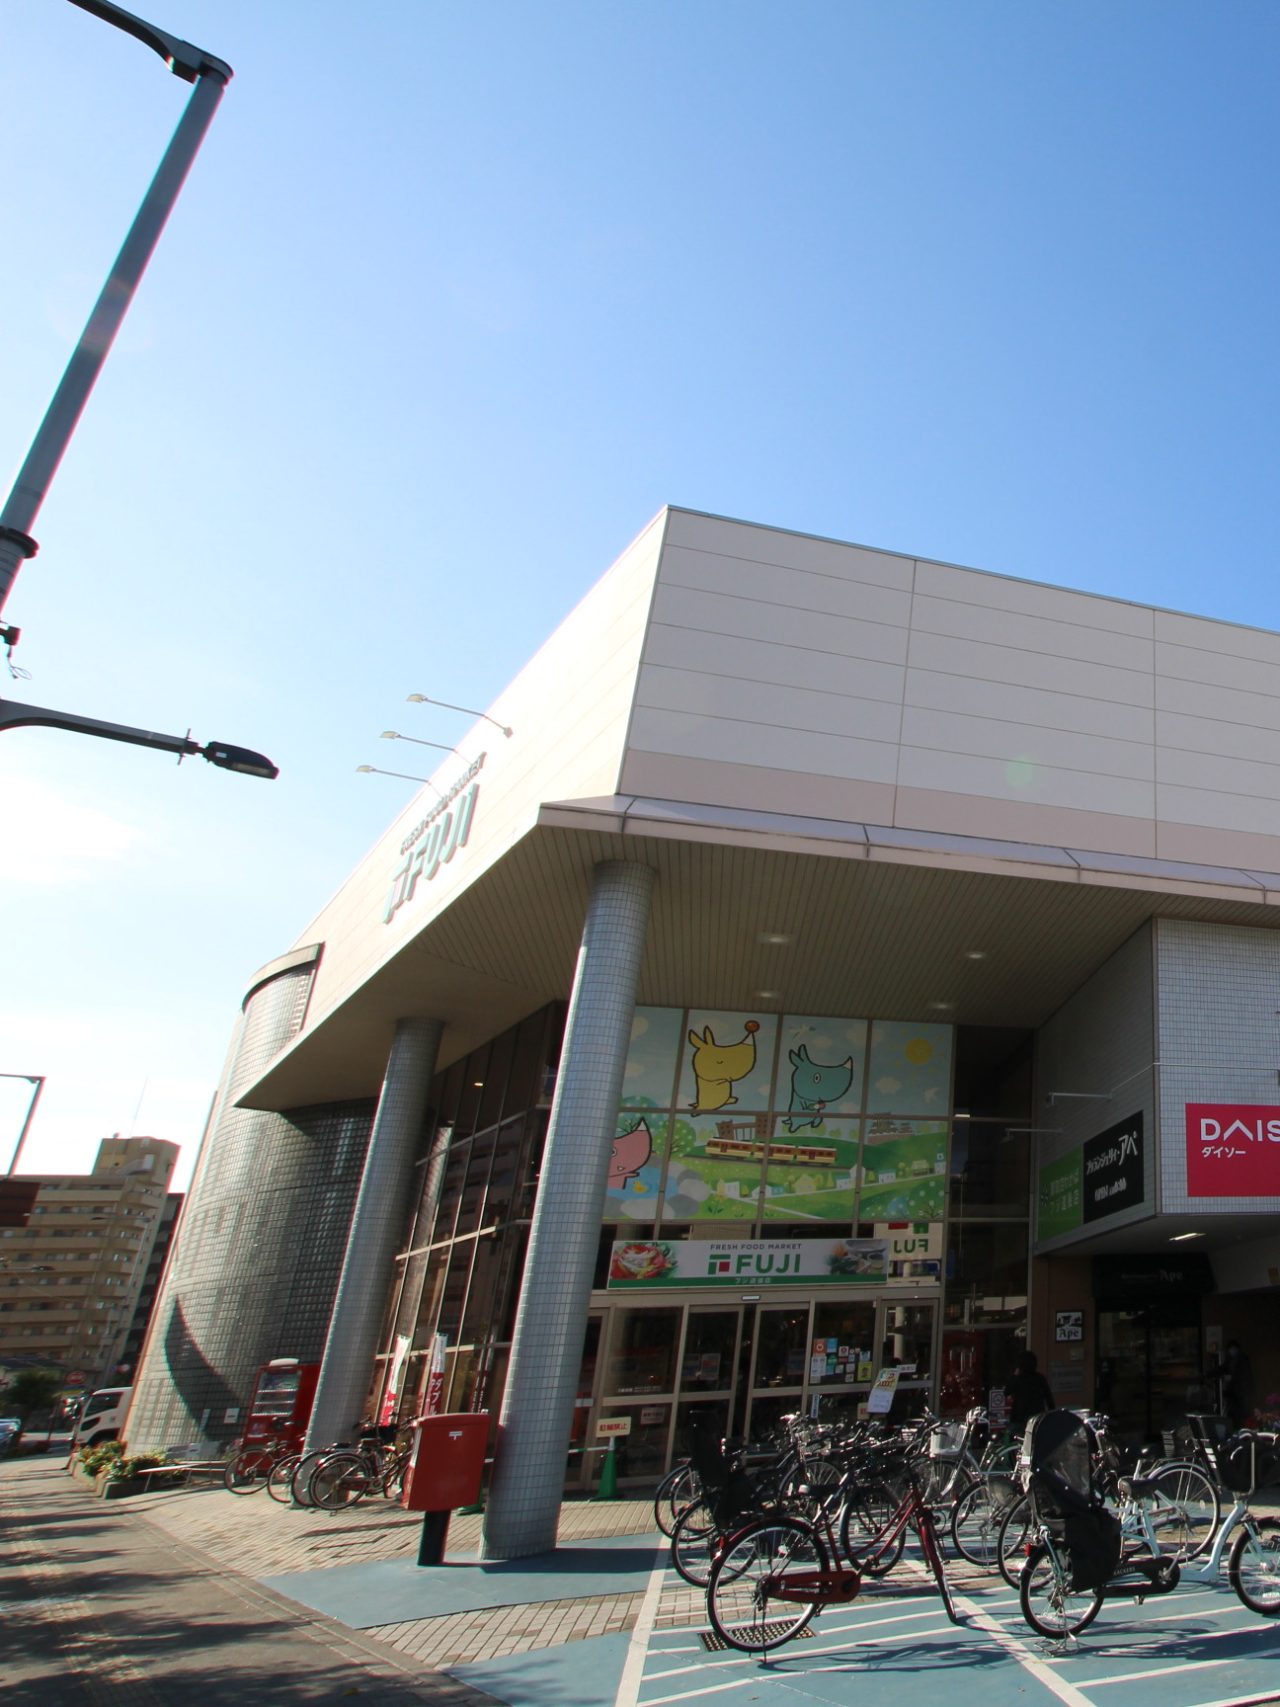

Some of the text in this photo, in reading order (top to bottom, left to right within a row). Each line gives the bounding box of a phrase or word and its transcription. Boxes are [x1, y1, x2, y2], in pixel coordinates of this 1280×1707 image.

[1200, 1145, 1247, 1159] ダイソー
[710, 1243, 739, 1251] FRESH
[768, 1242, 803, 1250] MARKET
[735, 1253, 801, 1274] FUJI
